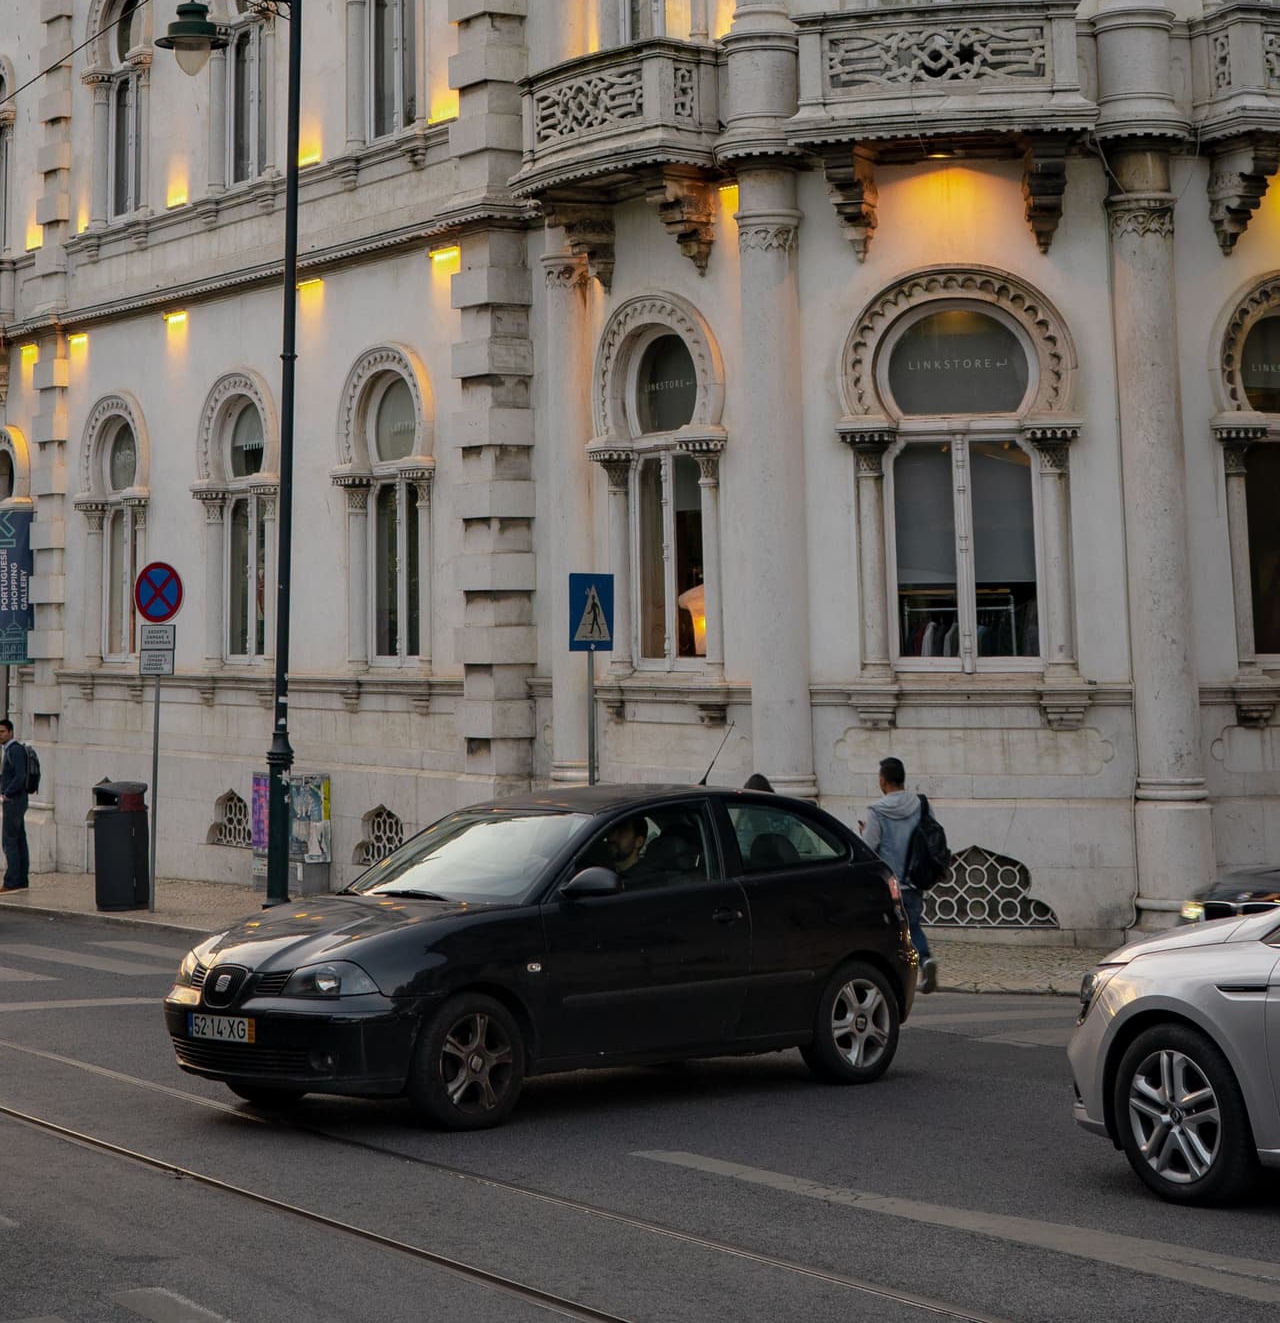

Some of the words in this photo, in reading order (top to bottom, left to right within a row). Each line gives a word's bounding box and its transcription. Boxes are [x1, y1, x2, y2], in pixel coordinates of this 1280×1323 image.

[907, 358, 992, 371] LINKSTORE
[0, 548, 9, 612] PORTUGUESE
[9, 562, 19, 611] SHOPPING
[20, 569, 28, 611] GALLERY
